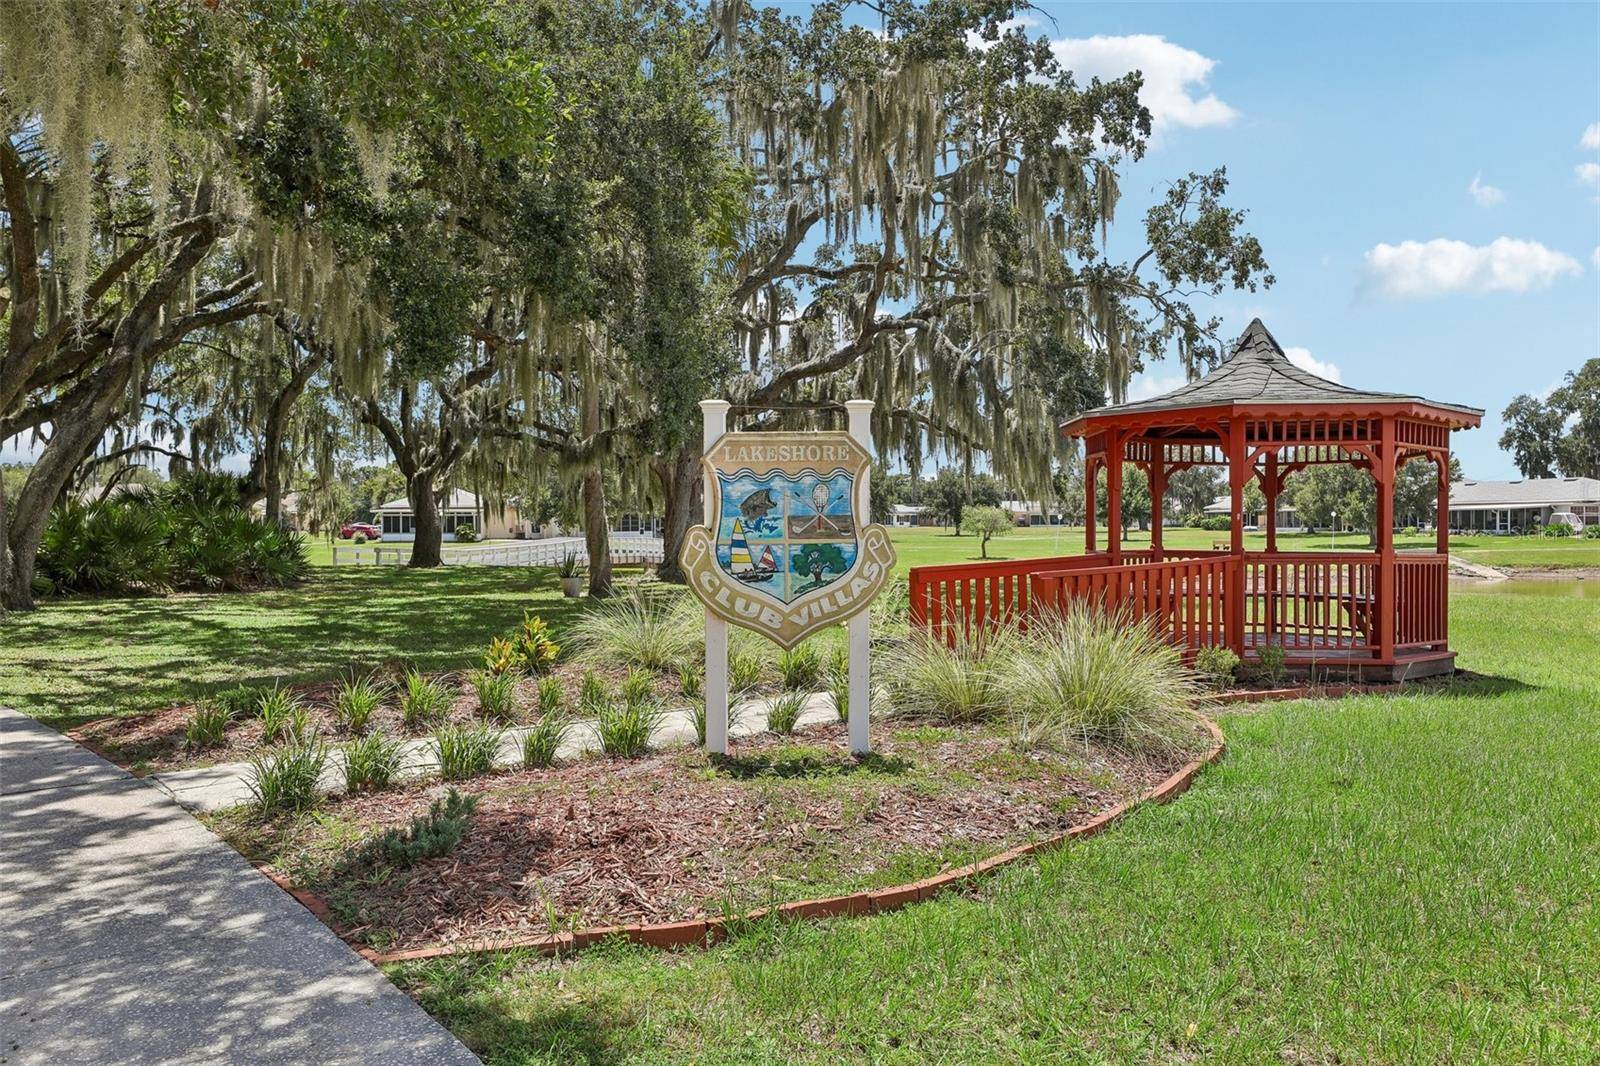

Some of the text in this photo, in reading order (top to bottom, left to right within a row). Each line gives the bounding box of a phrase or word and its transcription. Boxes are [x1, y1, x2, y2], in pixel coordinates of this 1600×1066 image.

[724, 445, 850, 462] LAKESHORE
[700, 561, 880, 629] CLUB VILLAS
